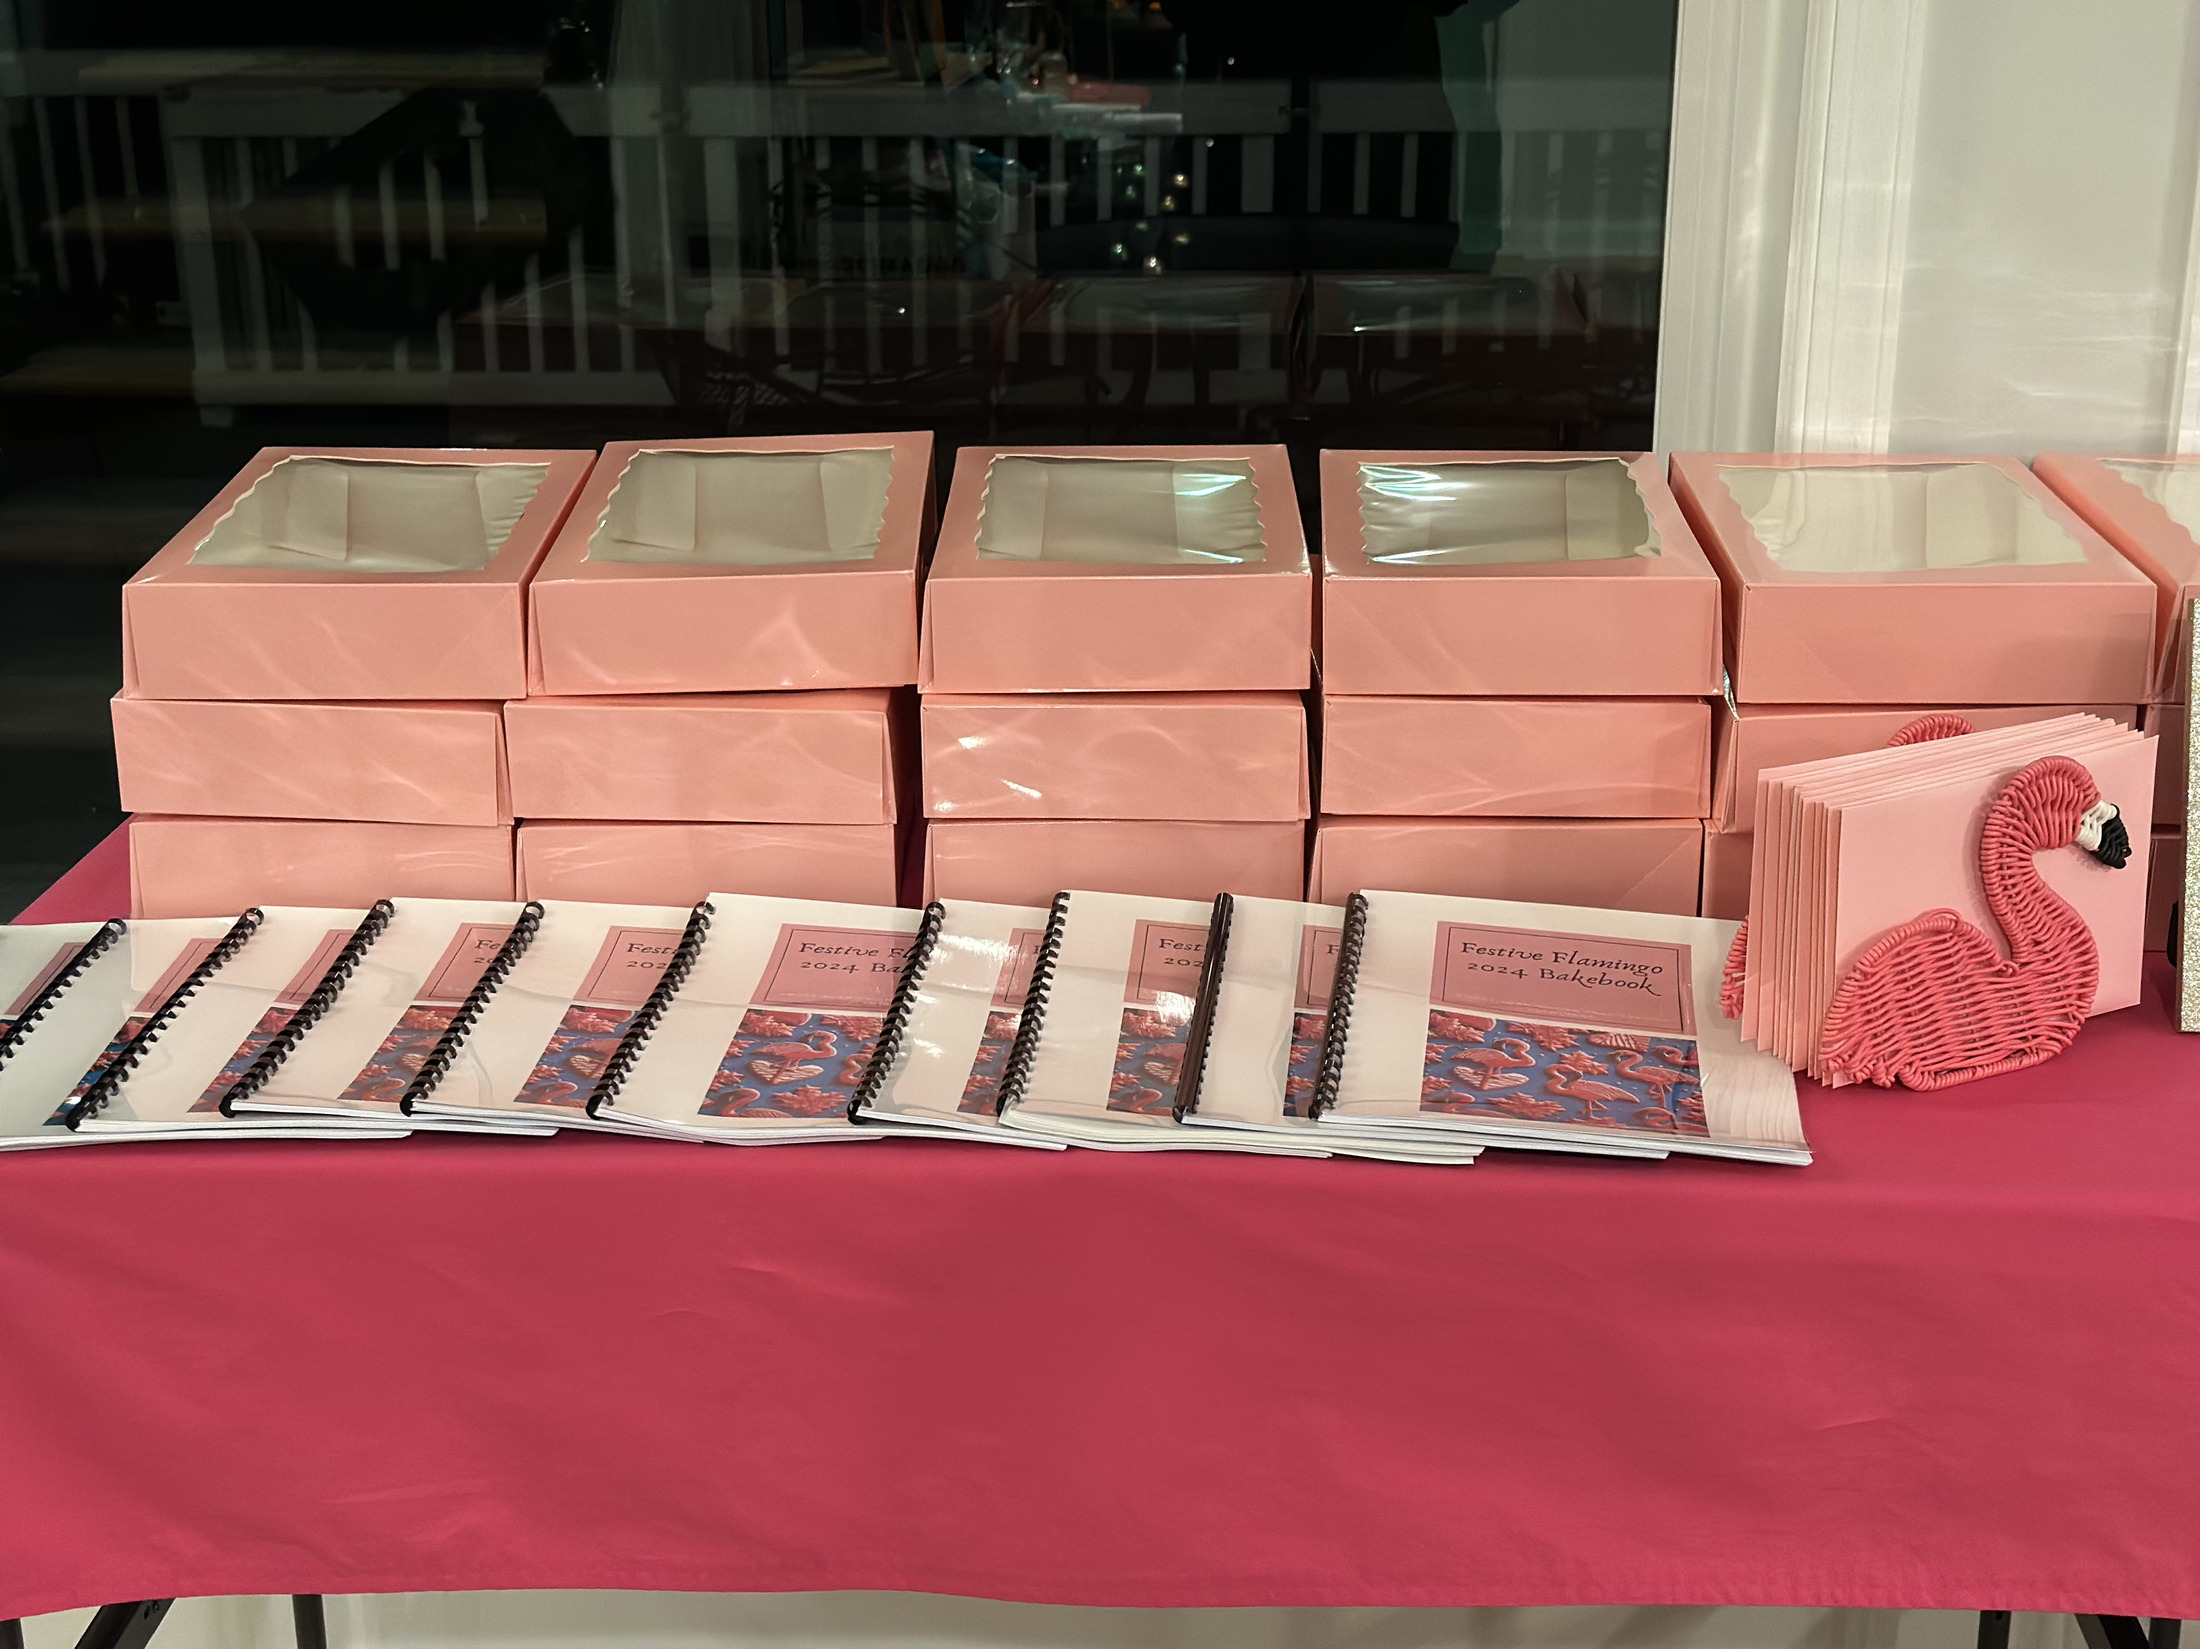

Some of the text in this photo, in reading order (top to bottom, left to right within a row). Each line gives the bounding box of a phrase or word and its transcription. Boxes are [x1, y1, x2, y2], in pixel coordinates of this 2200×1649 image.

[799, 943, 879, 957] Festive
[1159, 938, 1204, 951] Fest
[627, 961, 667, 969] 202
[1164, 957, 1204, 967] 202
[1461, 942, 1663, 977] Festive Flamingo
[801, 961, 859, 973] 2024
[1467, 962, 1661, 996] 2024 Bakebook
